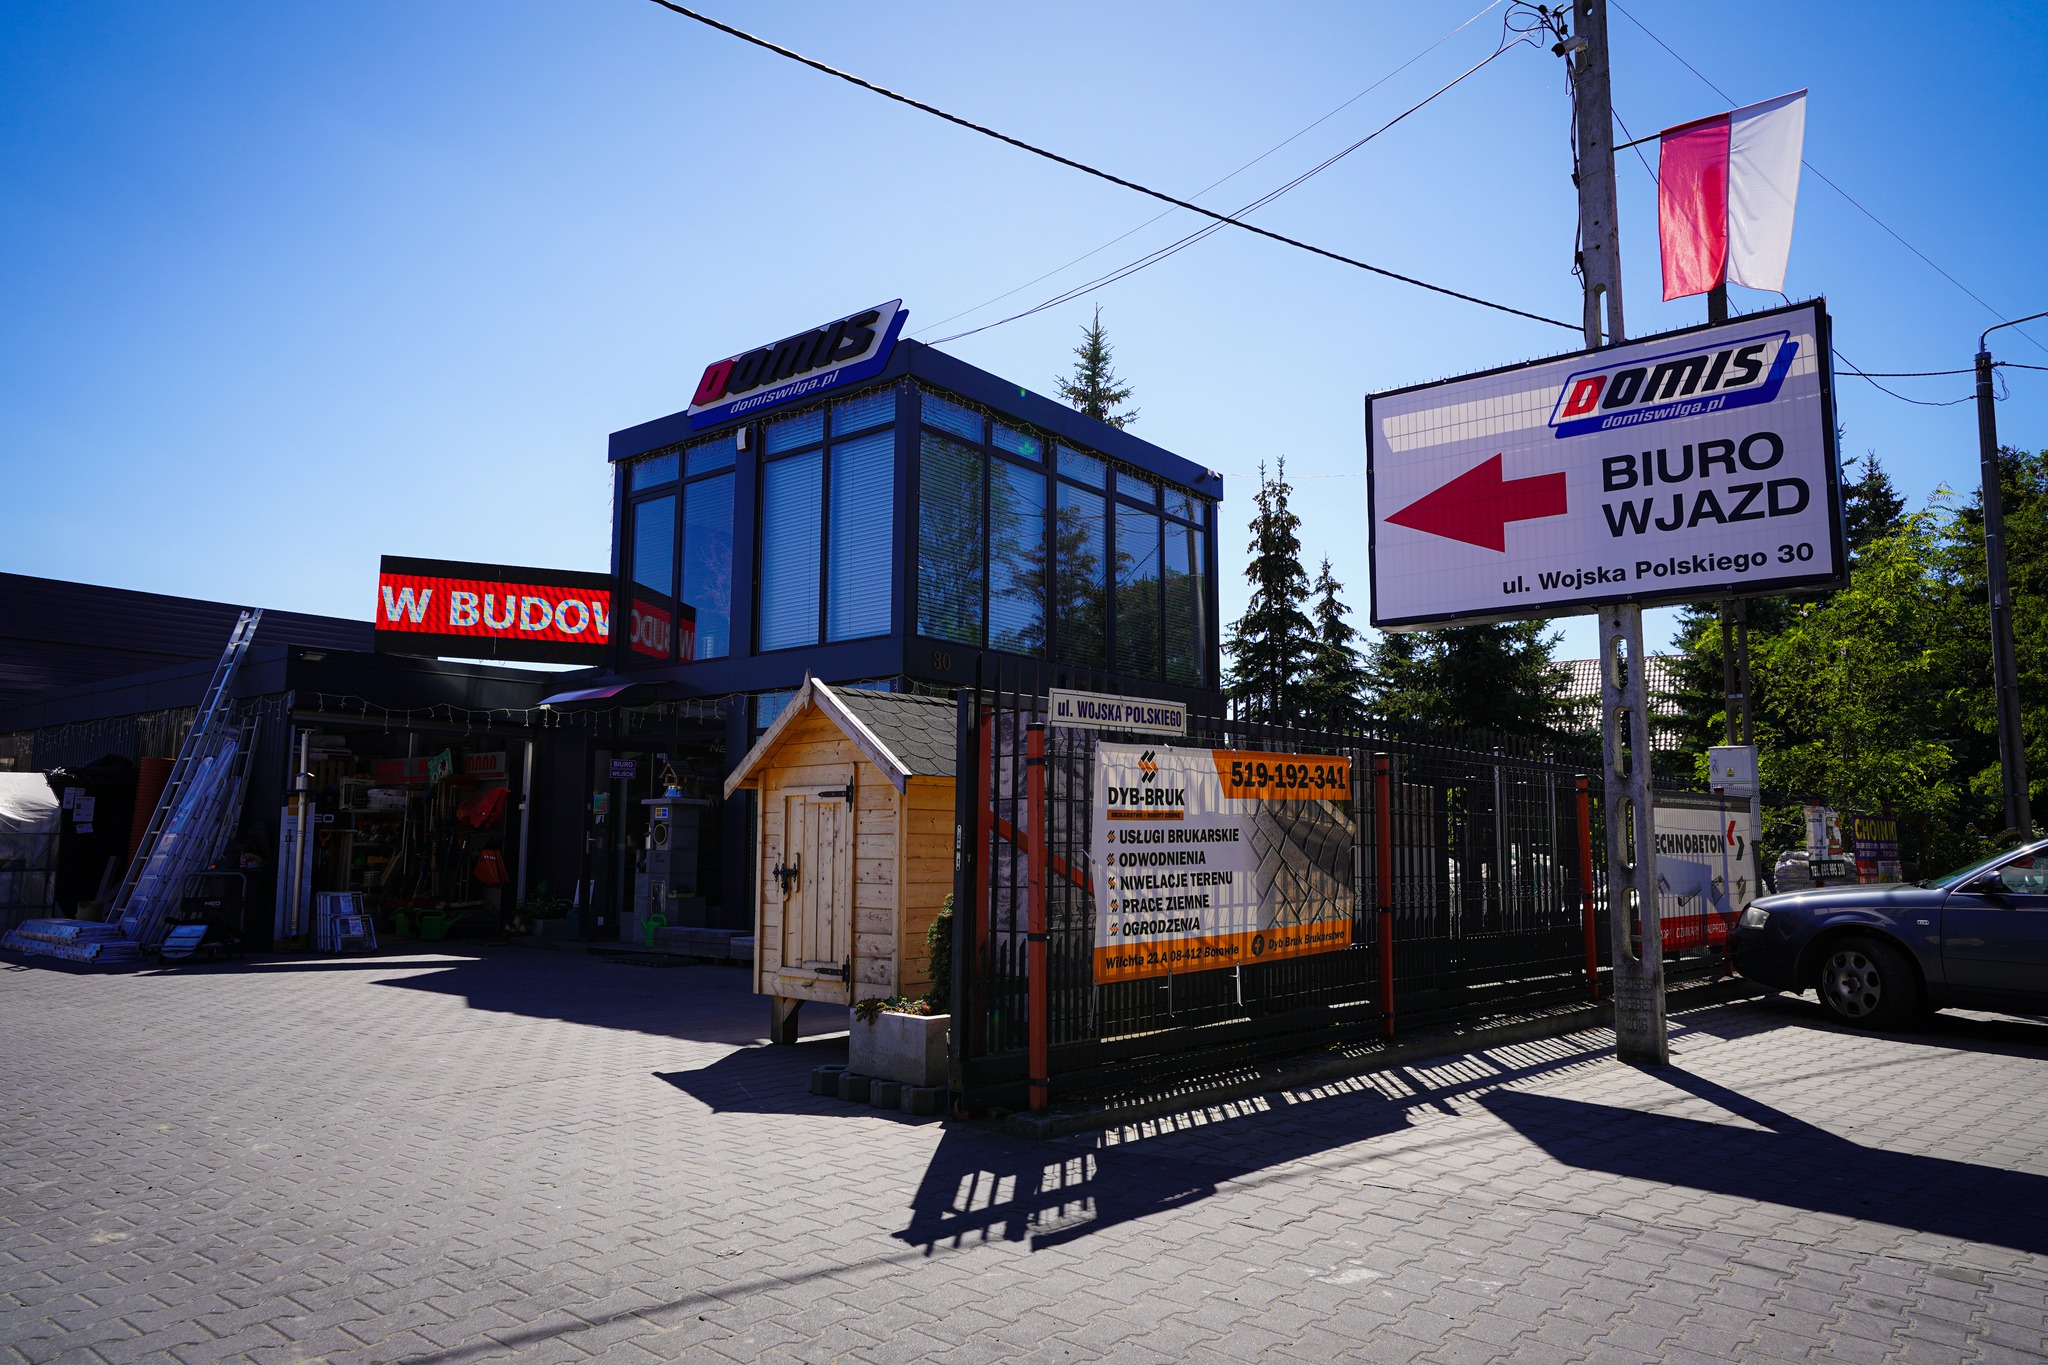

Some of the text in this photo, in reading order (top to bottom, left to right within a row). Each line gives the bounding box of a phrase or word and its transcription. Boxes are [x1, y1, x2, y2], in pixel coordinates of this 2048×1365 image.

[730, 369, 840, 414] domiswilga.pl
[1562, 343, 1766, 418] DOMIS
[1601, 396, 1726, 429] domiswilga.pl
[1602, 431, 1785, 493] BIURO
[1602, 477, 1811, 537] WJAZD
[1503, 542, 1814, 594] ul. Wojska Polskiego 30
[381, 586, 433, 623] W
[933, 651, 951, 671] 30
[1058, 700, 1182, 728] ul. WOJSKA POLSKIEGO
[1231, 761, 1346, 790] 519-192-341
[1108, 787, 1185, 806] DYB-BRUK
[314, 813, 335, 823] EO
[1855, 819, 1897, 840] CHOINKI
[1119, 828, 1240, 844] USŁUGI BRUKARSKIE
[1655, 833, 1725, 854] ECHNOBETON
[1119, 851, 1206, 867] ODWODNIENIA
[1120, 871, 1233, 891] NIWELACJE TERENU
[1122, 894, 1210, 914] PRACE ZIEMNE
[1122, 917, 1200, 937] OGRODZENIA
[1268, 926, 1345, 950] Dyb Bruk Brukarstwo
[1106, 952, 1144, 970] Wilchta
[1160, 948, 1168, 964] A
[1170, 946, 1202, 963] 08-412
[1205, 943, 1239, 958] Borowie
